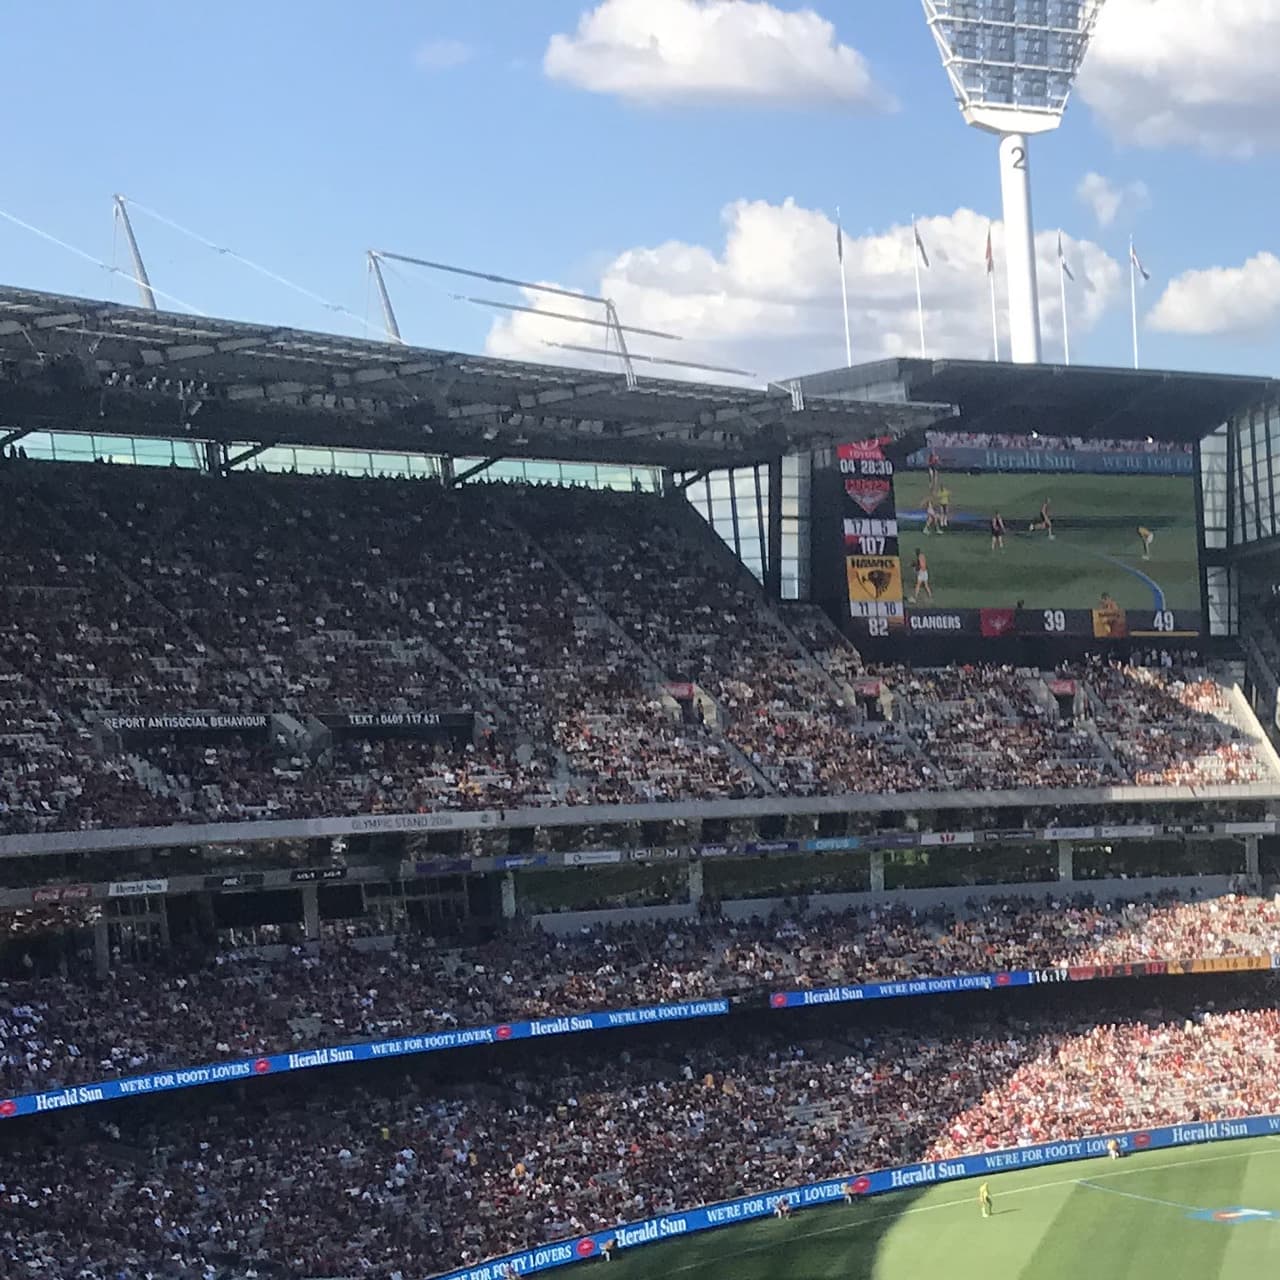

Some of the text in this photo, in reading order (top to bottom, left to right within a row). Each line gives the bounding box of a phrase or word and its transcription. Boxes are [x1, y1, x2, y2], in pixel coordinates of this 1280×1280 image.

[1010, 146, 1026, 170] 2
[858, 537, 886, 555] 107
[868, 618, 889, 636] 82
[910, 614, 961, 631] CLANGERS
[1043, 610, 1066, 632] 39
[1153, 610, 1175, 632] 49
[148, 715, 208, 728] ANTISOCIAL
[210, 715, 267, 728] BEHAVIOUR
[348, 714, 373, 725] TEXT
[804, 986, 863, 1004] Herald Sun
[879, 975, 992, 996] WE'RE FOR FOOTY LOVERS
[608, 1000, 727, 1025] WE'RE FOR FOOTY LOVERS
[530, 1015, 593, 1036] Herald Sun
[371, 1029, 492, 1056] WE'RE FOR FOOTY LOVERS
[288, 1048, 354, 1070] Herald Sun
[119, 1062, 250, 1093] WE'RE FOR FOOTY LOVERS
[35, 1086, 103, 1112] Herald Sun
[1172, 1117, 1248, 1143] Herald Sun
[985, 1143, 1082, 1169] WE'RE FOR FOOTY
[891, 1161, 966, 1187] Herald Sun
[706, 1180, 849, 1225] WE'RE FOR LOVERS
[614, 1217, 687, 1249] Herald Sun
[529, 1245, 572, 1268] LOVERS
